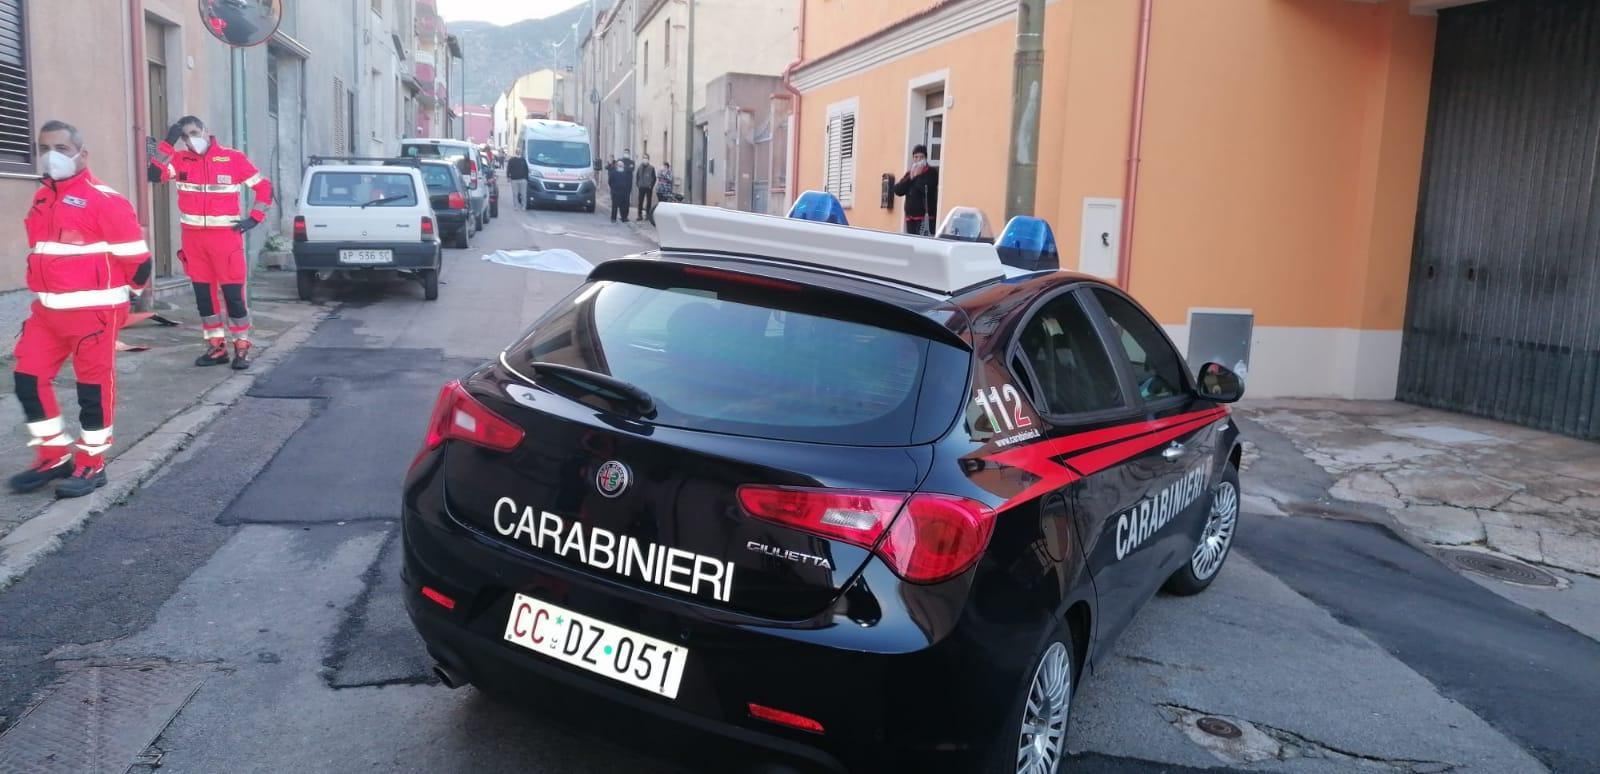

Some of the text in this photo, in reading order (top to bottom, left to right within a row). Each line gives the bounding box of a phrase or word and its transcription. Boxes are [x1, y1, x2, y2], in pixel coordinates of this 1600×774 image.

[975, 384, 1031, 433] 112
[493, 497, 735, 602] CARABINIERI
[1116, 464, 1205, 560] CARABINIERI
[747, 541, 831, 569] GIULIETTA
[514, 603, 673, 688] CC DZ 051
